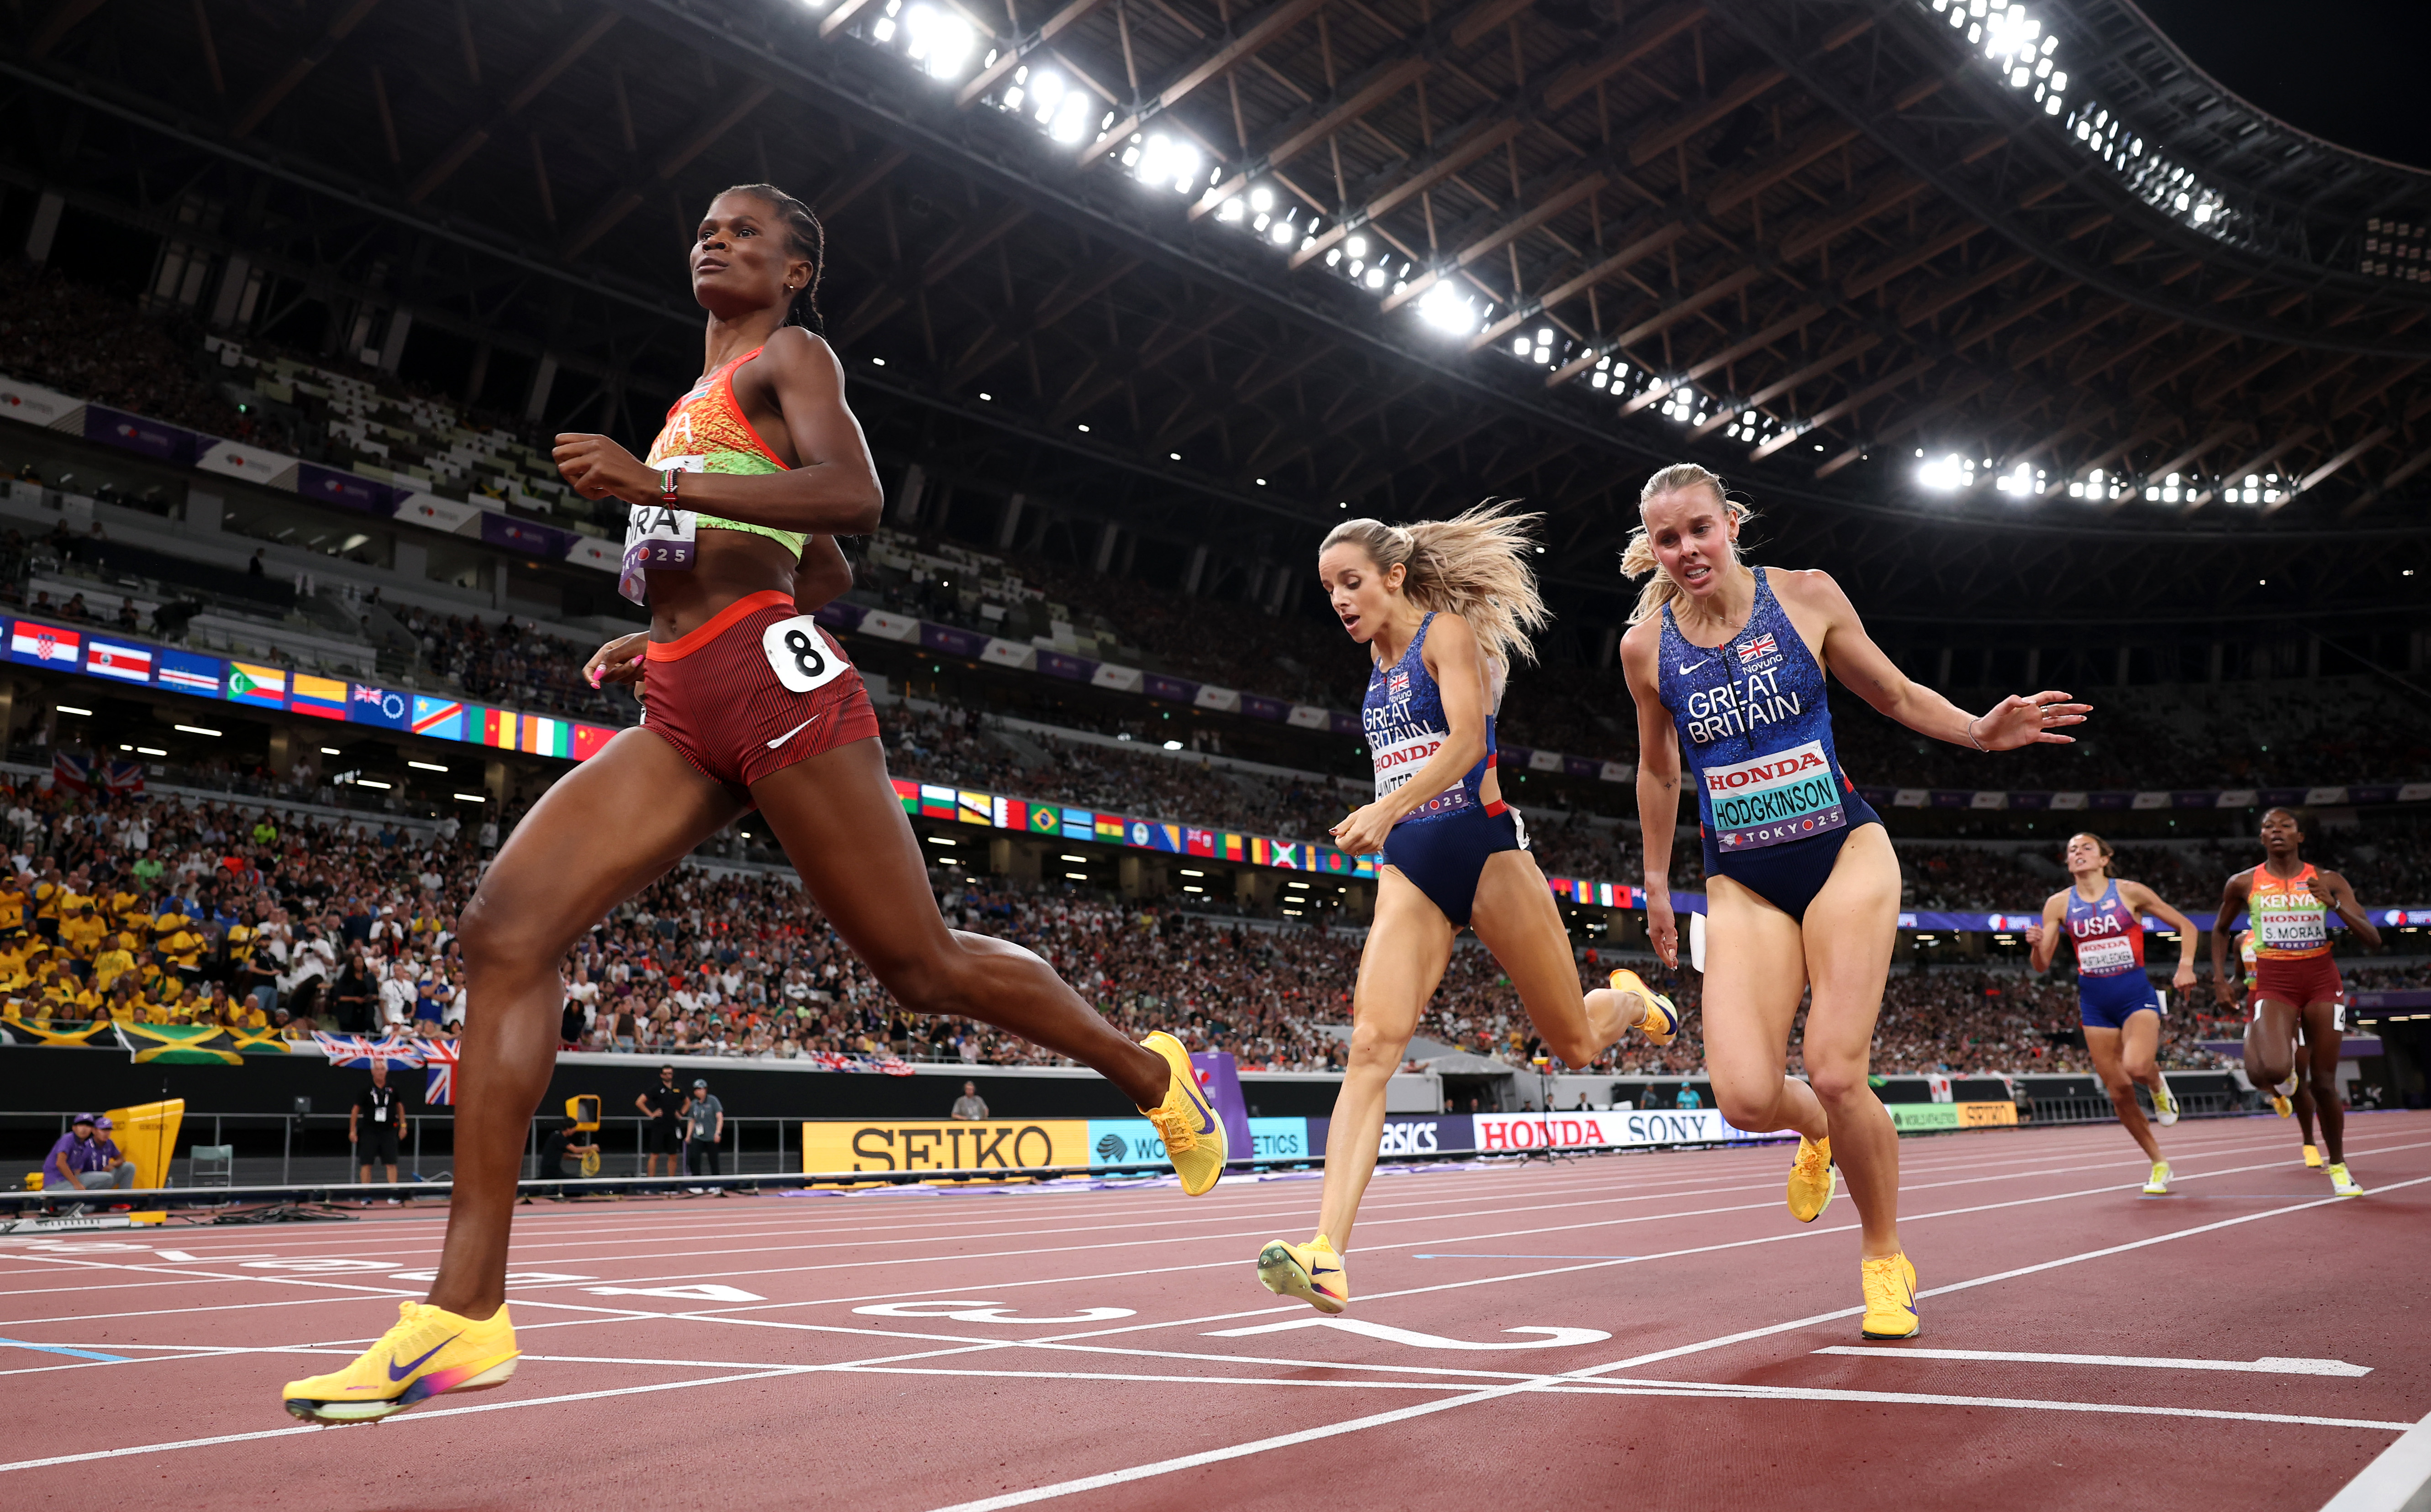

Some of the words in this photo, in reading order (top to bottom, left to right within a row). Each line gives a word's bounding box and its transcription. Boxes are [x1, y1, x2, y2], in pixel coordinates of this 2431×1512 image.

[656, 548, 685, 562] 25
[784, 630, 825, 677] 8
[1743, 653, 1783, 675] Novuna
[1389, 690, 1412, 703] Novuna
[1688, 667, 1779, 719] GREAT
[1363, 698, 1411, 731] GREAT
[1688, 691, 1800, 743] BRITAIN
[1365, 719, 1432, 751] BRITAIN
[1374, 741, 1441, 773] HONDA
[1710, 752, 1825, 791] HONDA
[1443, 793, 1463, 807] 25
[1715, 777, 1834, 828] HODGKINSON
[1818, 812, 1839, 826] 25
[2260, 893, 2318, 908] KENYA
[2073, 914, 2122, 938] USA
[2263, 914, 2321, 923] HONDA
[2081, 940, 2127, 953] HONDA
[2266, 928, 2276, 939] S.
[2278, 927, 2323, 939] MORAA
[1379, 1122, 1437, 1154] asics
[1481, 1120, 1605, 1150] HONDA
[1629, 1116, 1707, 1142] SONY
[852, 1126, 1052, 1172] SEIKO
[577, 1284, 769, 1302] 4
[851, 1300, 1137, 1324] 3
[1198, 1317, 1613, 1350] 2
[1809, 1344, 2375, 1377] 1
